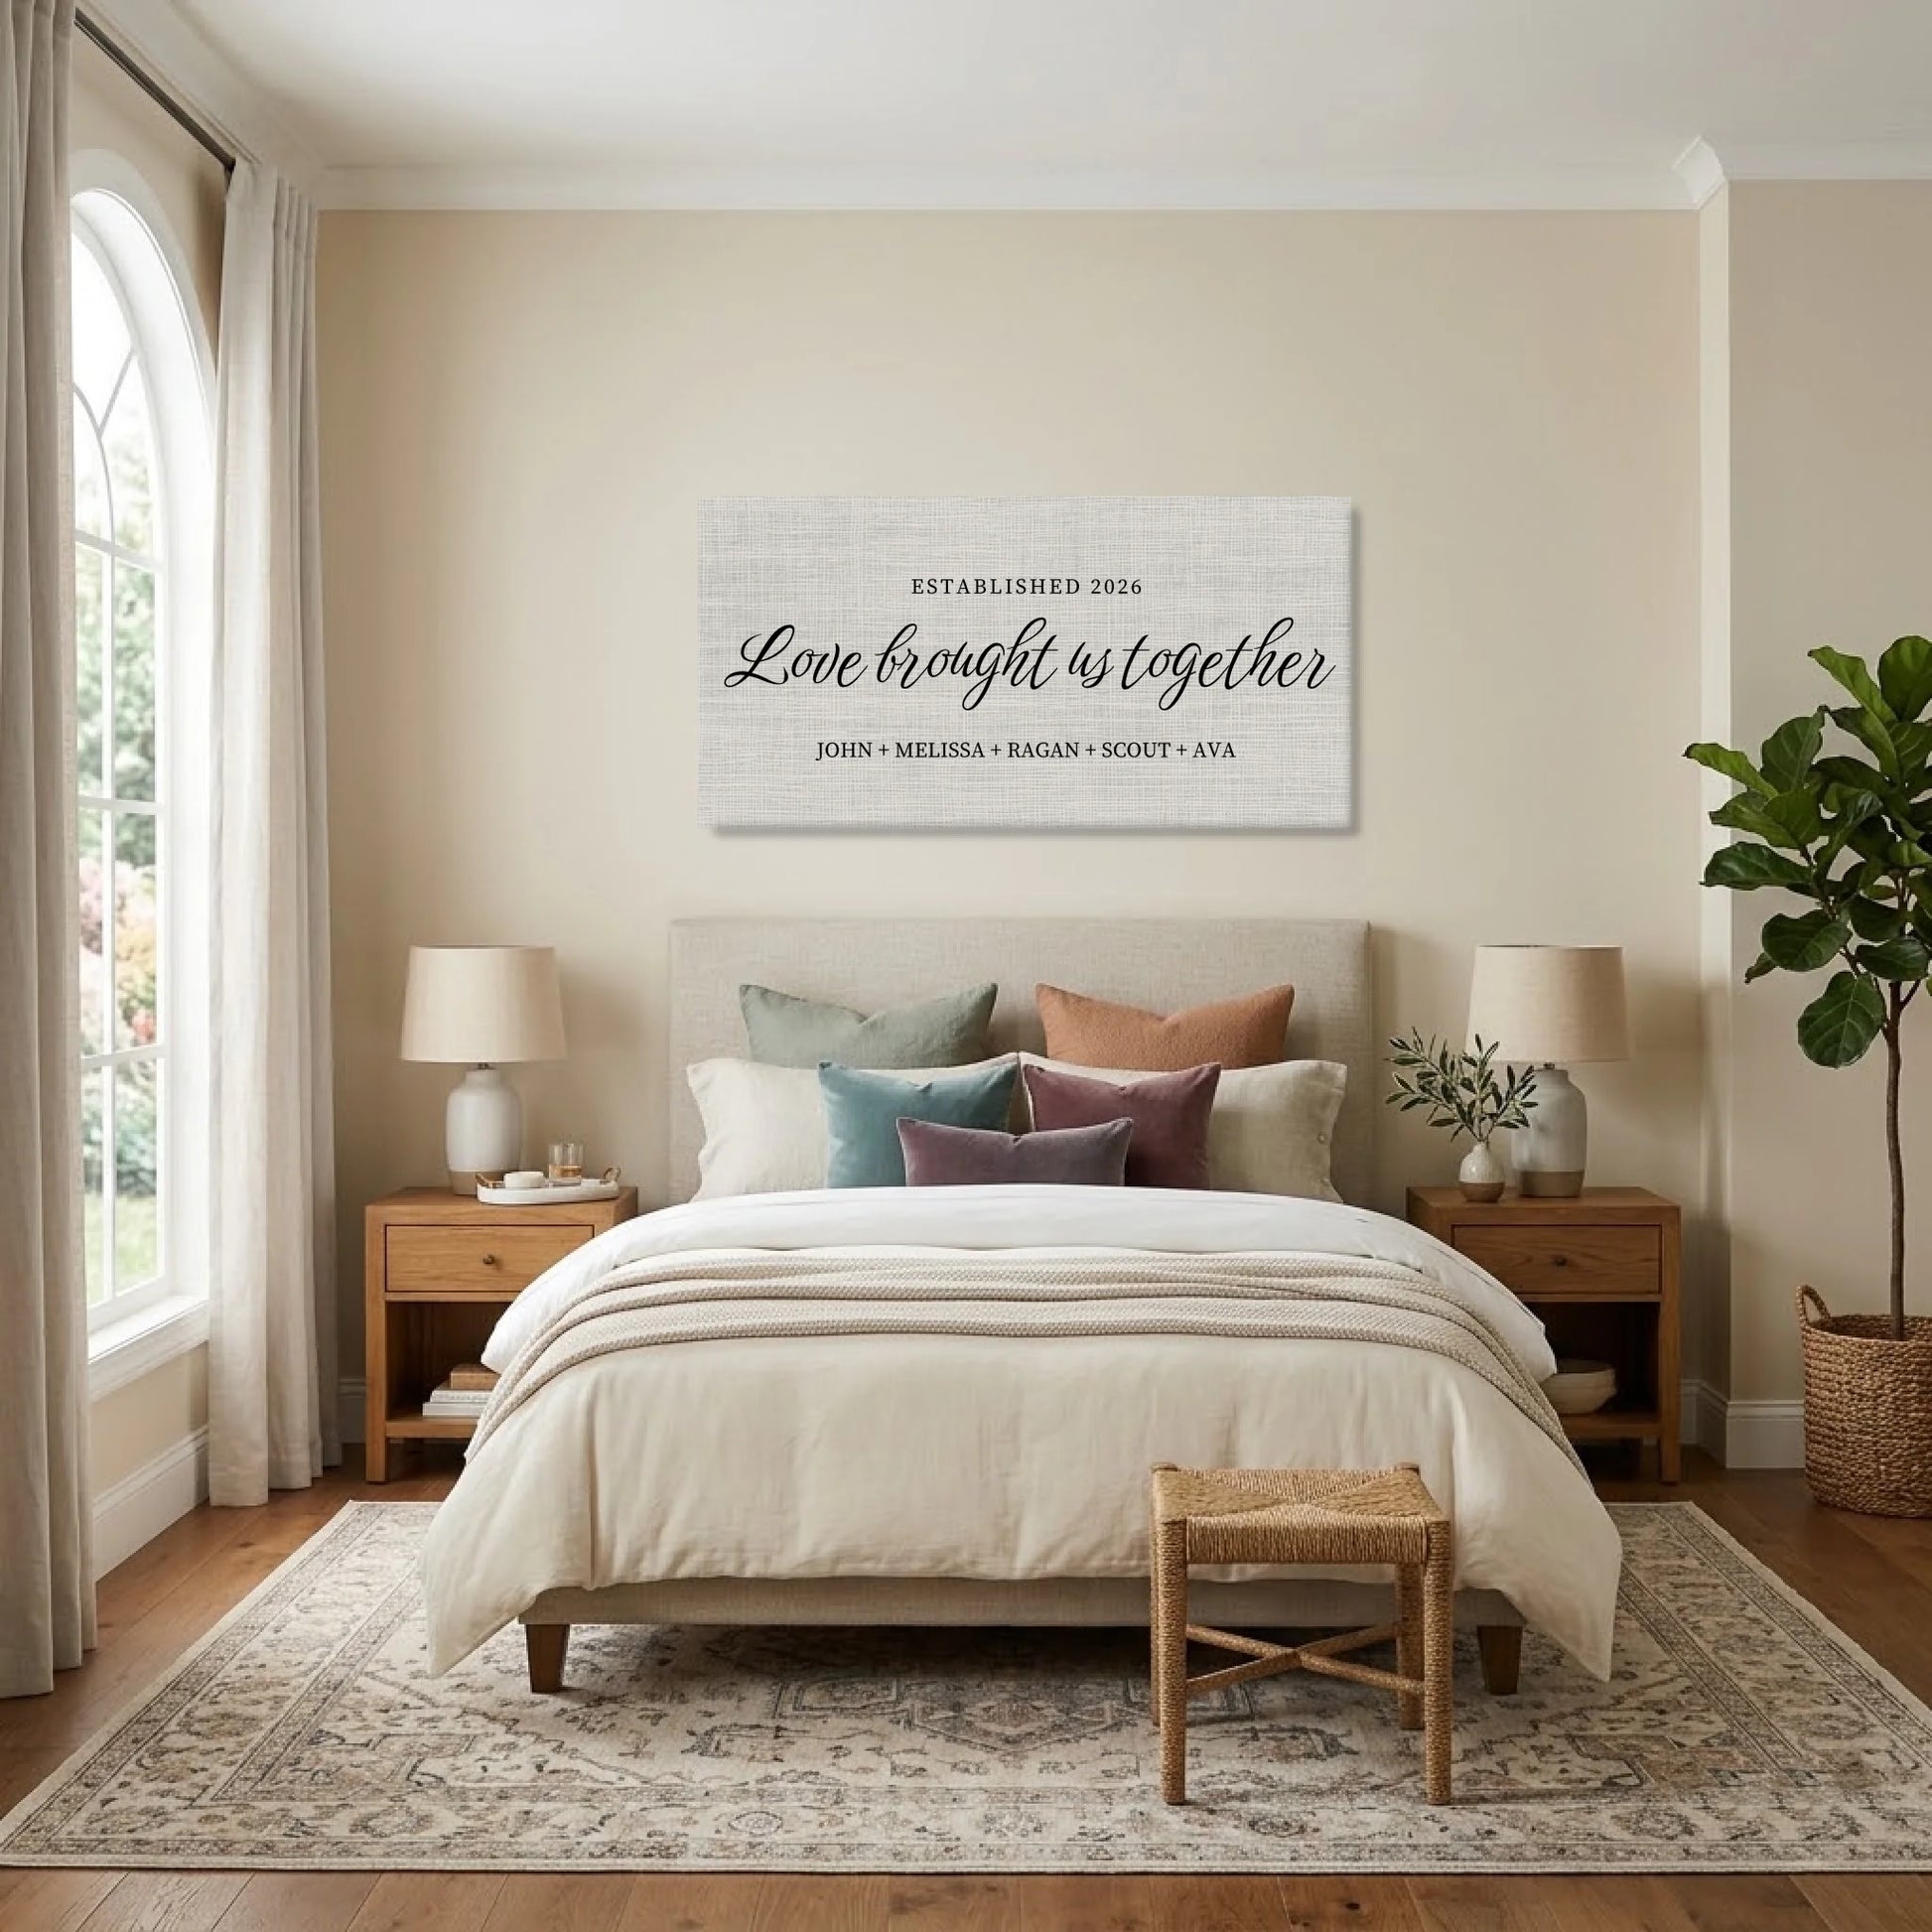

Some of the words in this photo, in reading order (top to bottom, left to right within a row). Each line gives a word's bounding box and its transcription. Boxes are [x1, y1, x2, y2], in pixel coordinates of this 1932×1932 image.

[911, 578, 1080, 595] ESTABLISHED
[1090, 578, 1142, 595] 2026
[723, 623, 869, 688] Love
[874, 617, 1059, 711] brought
[1067, 640, 1116, 689] us
[1121, 617, 1336, 712] together
[815, 742, 873, 761] JOHN
[895, 742, 986, 759] MELISSA
[1007, 742, 1080, 759] RAGAN
[1101, 742, 1172, 759] SCOUT
[1192, 742, 1237, 759] AVA
